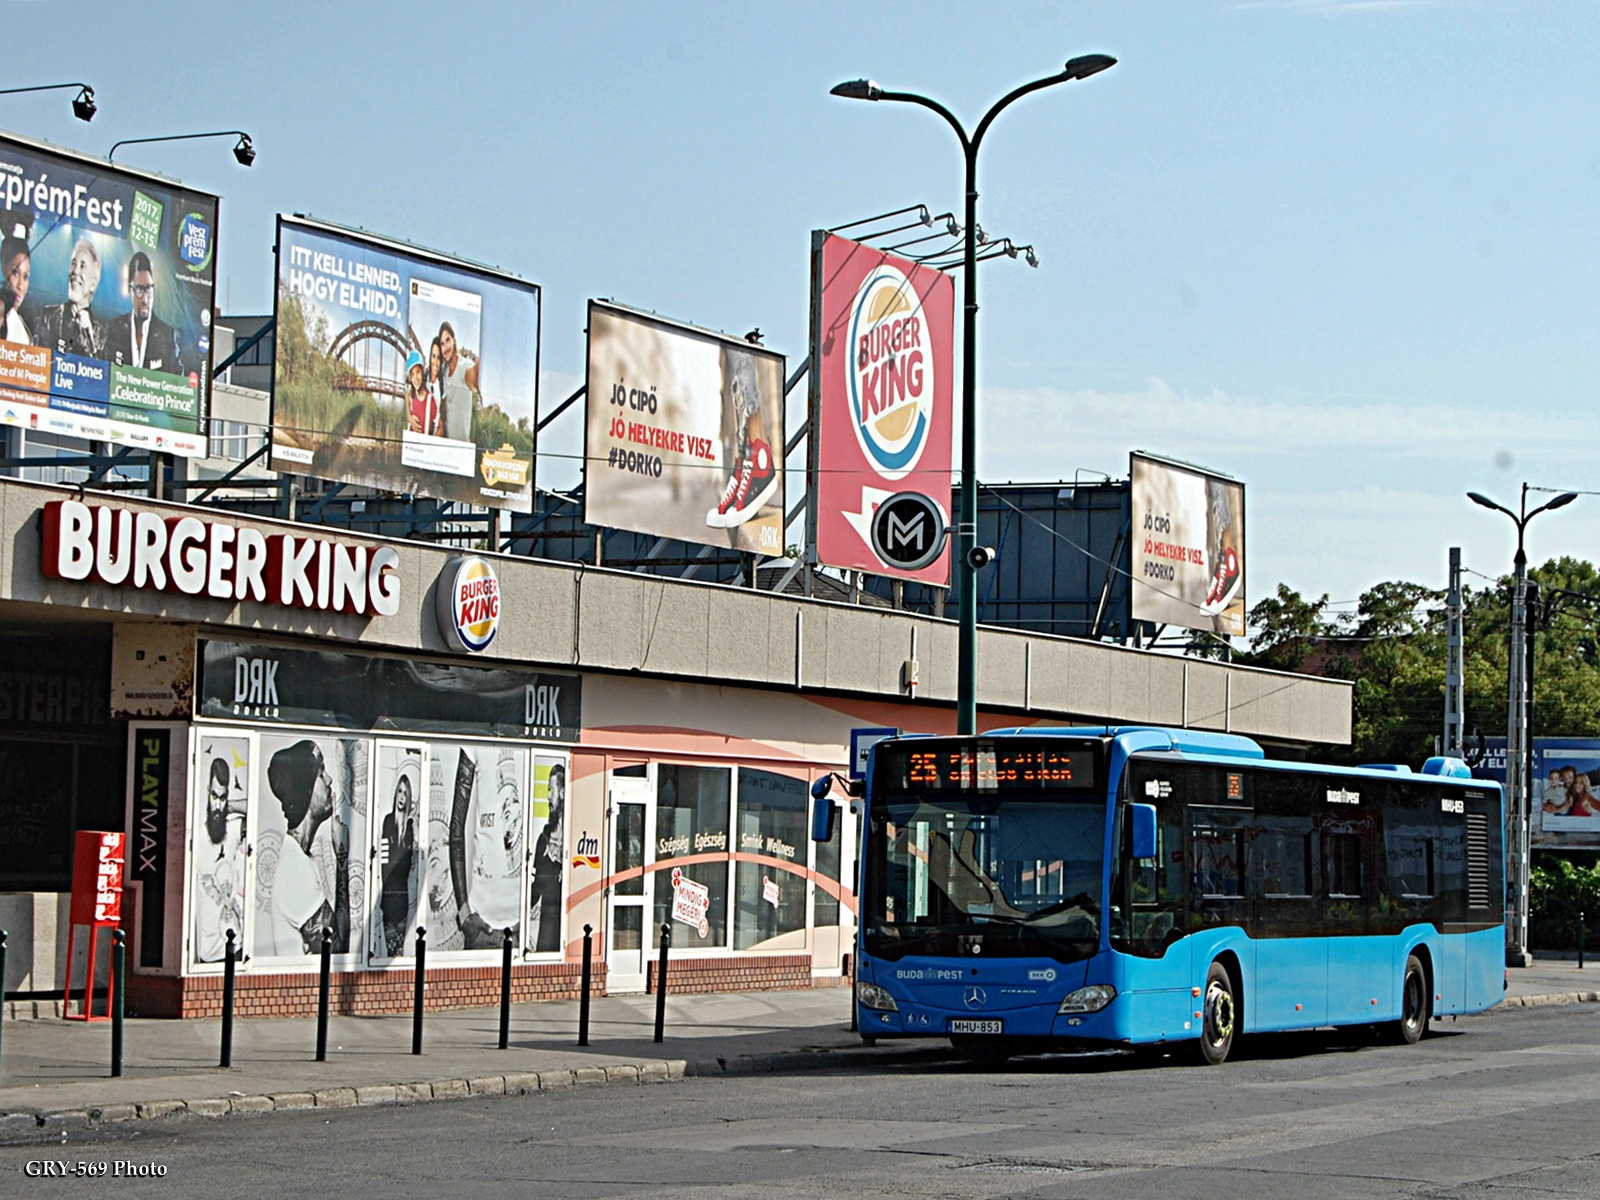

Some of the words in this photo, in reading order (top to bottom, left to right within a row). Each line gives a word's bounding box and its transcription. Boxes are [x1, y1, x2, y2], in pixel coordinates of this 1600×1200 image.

[136, 197, 159, 220] 2017.
[131, 225, 156, 249] 12-15.
[290, 244, 312, 269] ITT
[313, 251, 347, 279] KELL
[348, 260, 403, 295] LENNED,
[290, 268, 338, 303] HOGY
[339, 282, 402, 320] ELHIDD.
[858, 316, 921, 372] BURGER
[20, 349, 47, 368] Small
[55, 357, 76, 375] Tom
[76, 362, 104, 381] Jones
[54, 373, 74, 391] Live
[115, 372, 127, 384] The
[127, 374, 142, 387] New
[142, 377, 161, 391] Power
[161, 380, 194, 396] Generation
[609, 378, 627, 408] JÓ
[860, 350, 924, 424] KING
[609, 411, 626, 440] JÓ
[628, 421, 685, 454] HELYEKRE
[686, 434, 716, 462] VISZ.
[608, 446, 663, 479] #DORKO
[1144, 509, 1153, 531] JÓ
[57, 499, 268, 602] BURGER
[280, 534, 401, 617] KING
[1144, 534, 1153, 555] JÓ
[1154, 541, 1187, 563] HELYEKRE
[1187, 547, 1205, 567] VISZ.
[1143, 561, 1175, 582] #DORKO
[460, 579, 498, 603] BURGER
[460, 595, 498, 627] KING
[577, 831, 598, 855] dm
[659, 836, 688, 855] Szépség
[694, 831, 727, 852] Egészség
[741, 832, 764, 850] Smink
[766, 837, 796, 858] Wellness
[679, 885, 702, 907] MINDIG
[954, 1022, 1000, 1034] MHU-853
